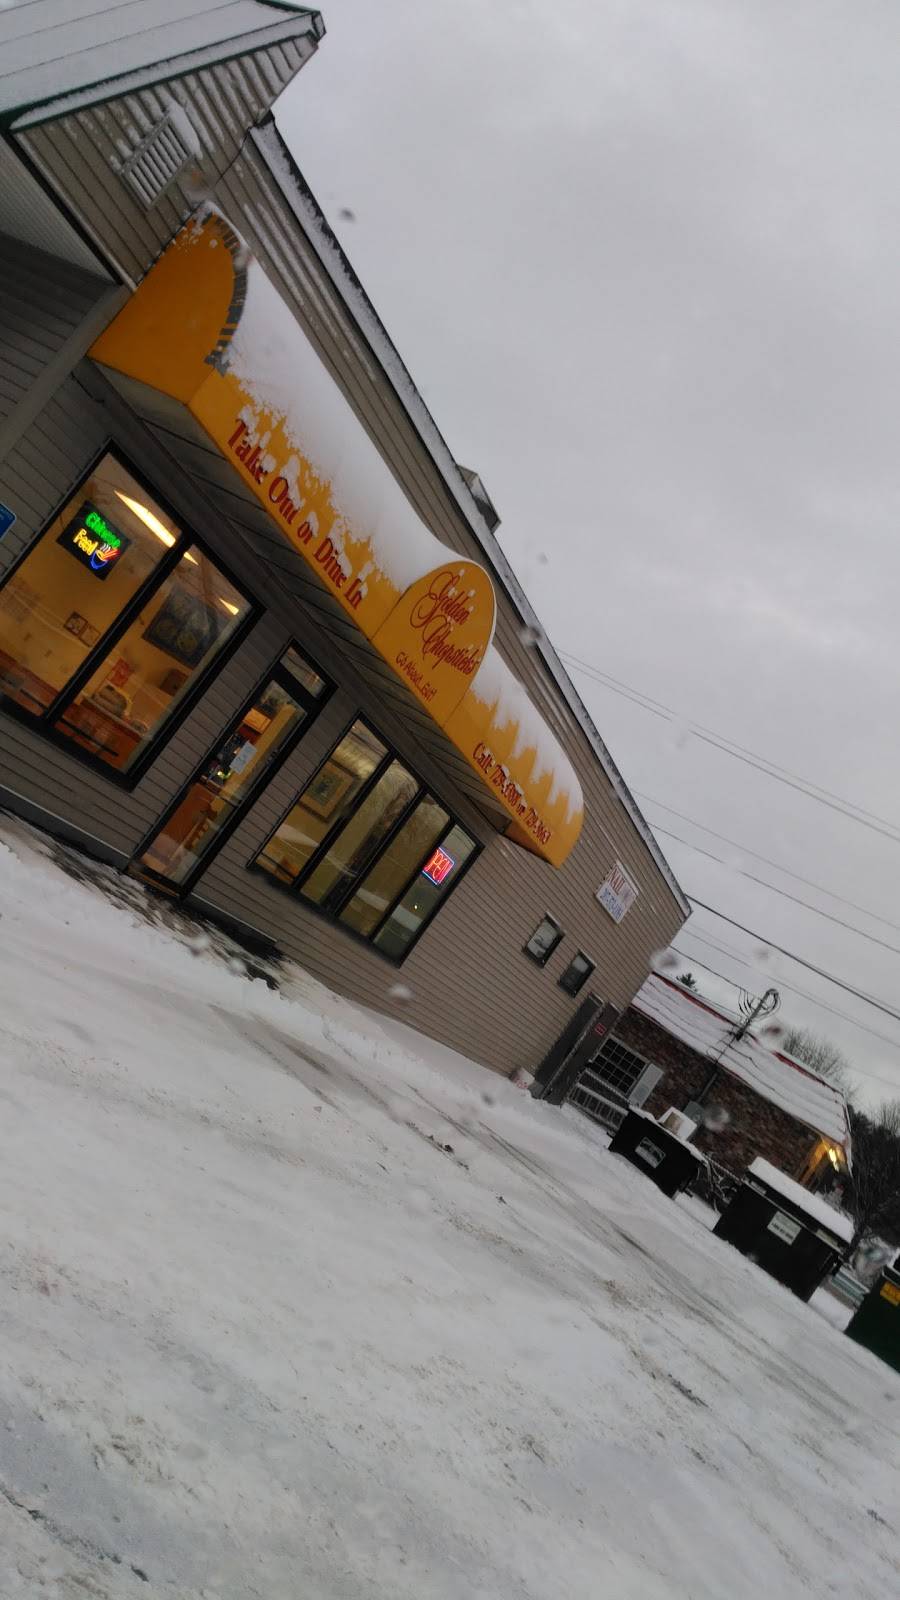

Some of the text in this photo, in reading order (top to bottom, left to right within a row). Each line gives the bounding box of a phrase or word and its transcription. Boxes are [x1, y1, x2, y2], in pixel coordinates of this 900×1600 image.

[73, 529, 99, 555] Food
[228, 419, 362, 609] Take Out or Dine In
